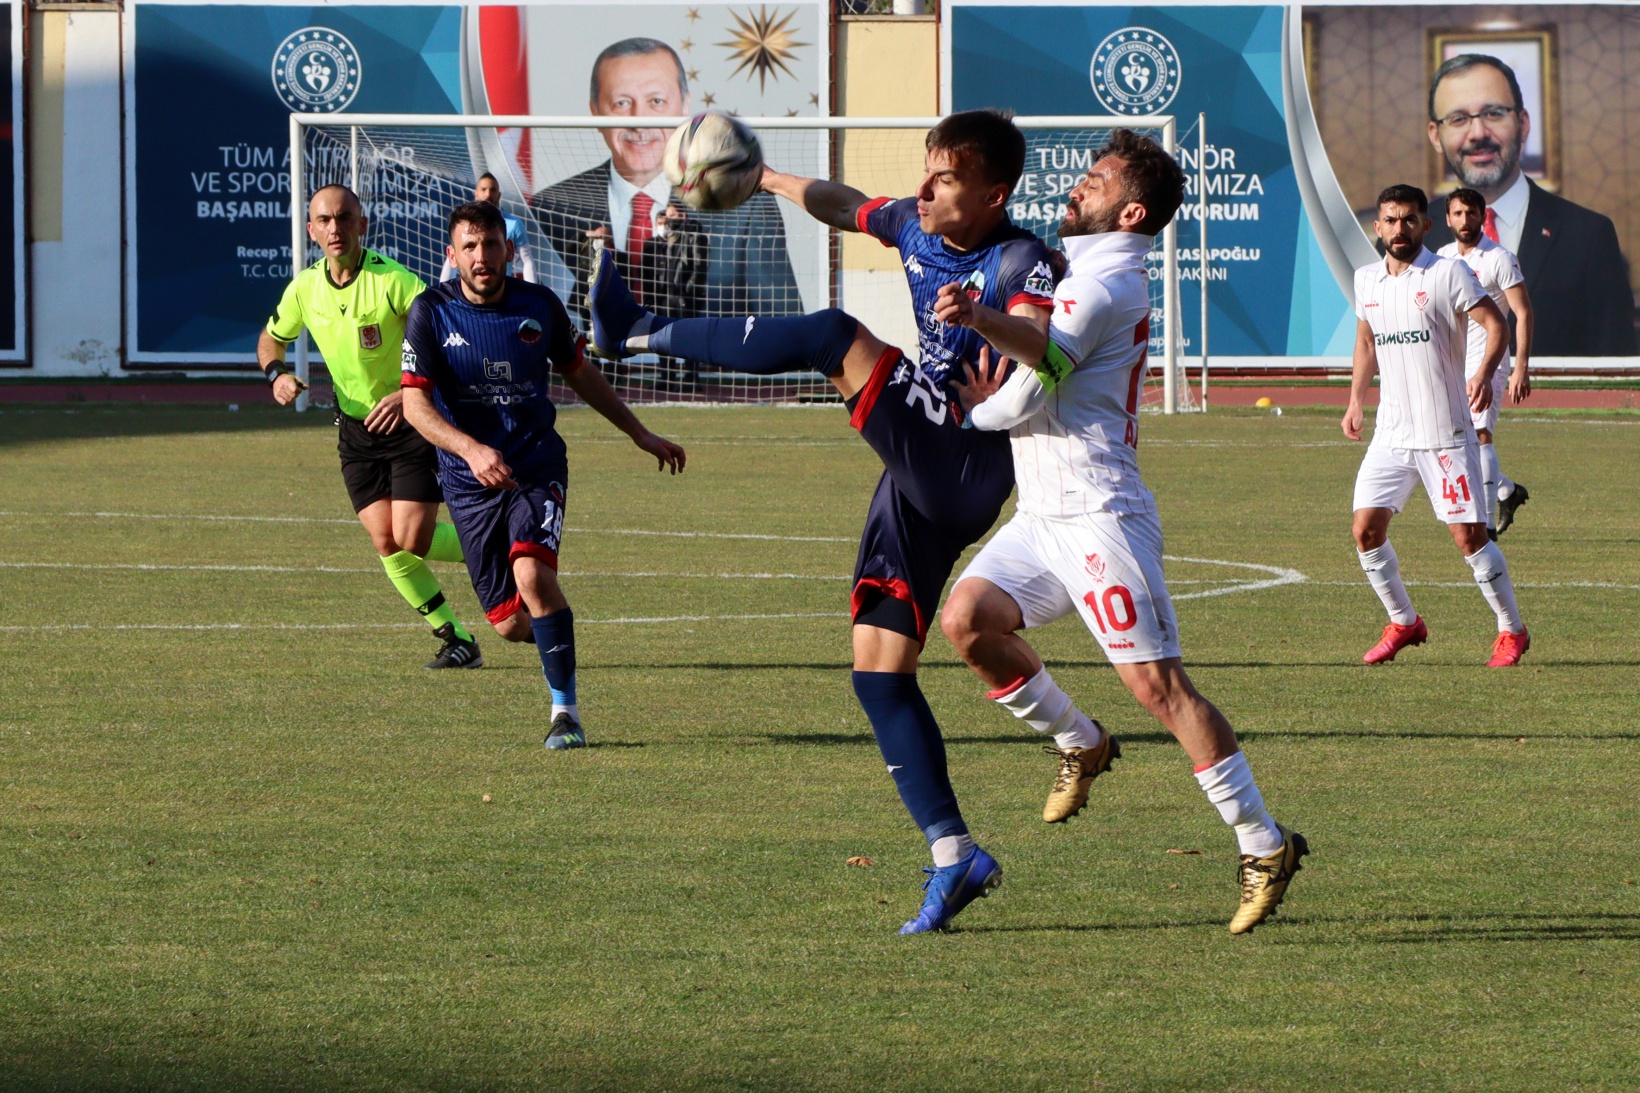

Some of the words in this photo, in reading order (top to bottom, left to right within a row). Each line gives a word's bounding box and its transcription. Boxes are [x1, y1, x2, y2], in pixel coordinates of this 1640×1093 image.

[219, 142, 274, 168] TÜM
[1035, 144, 1092, 169] TÜM
[191, 172, 221, 193] VE
[237, 246, 278, 260] Recep
[241, 264, 265, 277] T.C.
[1442, 474, 1471, 504] 41
[541, 500, 562, 541] 18
[1083, 585, 1138, 634] 10
